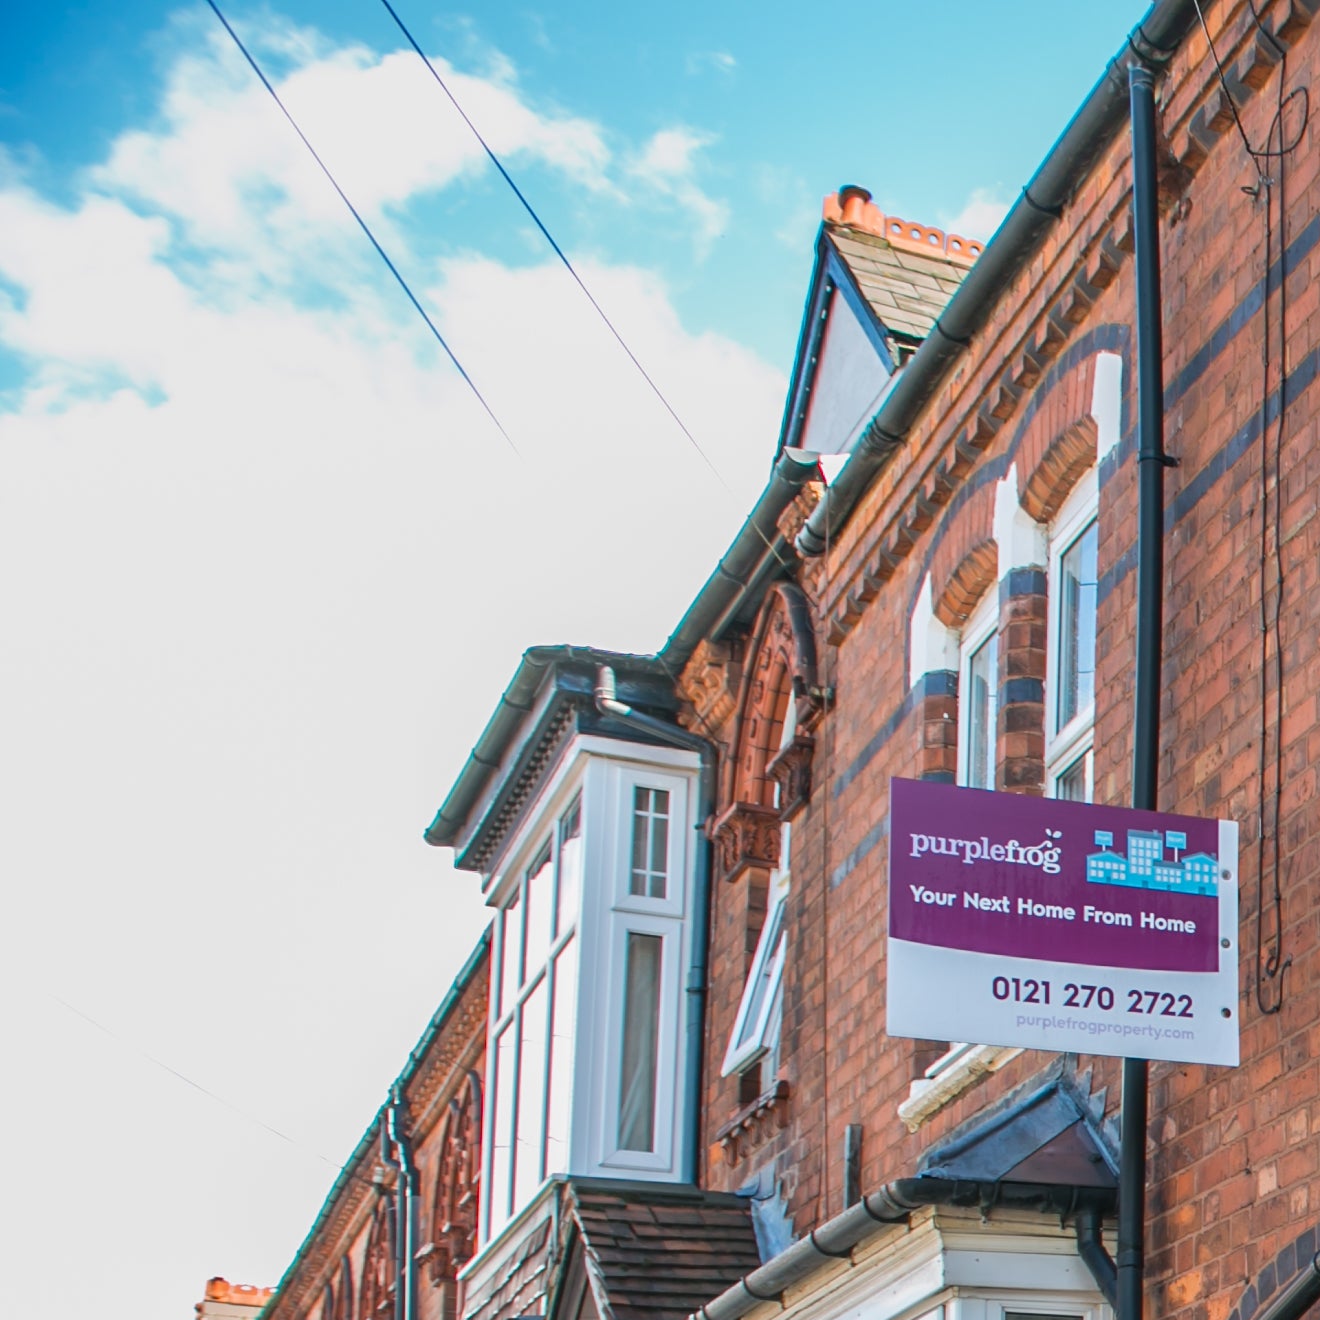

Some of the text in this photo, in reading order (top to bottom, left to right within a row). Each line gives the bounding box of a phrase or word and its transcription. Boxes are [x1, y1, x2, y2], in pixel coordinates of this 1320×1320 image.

[909, 832, 1063, 874] purplefrog
[909, 884, 1197, 934] Your Next Home From Home
[992, 976, 1194, 1018] 0121 270 2722
[1016, 1014, 1195, 1040] purplefrogproperty.com
